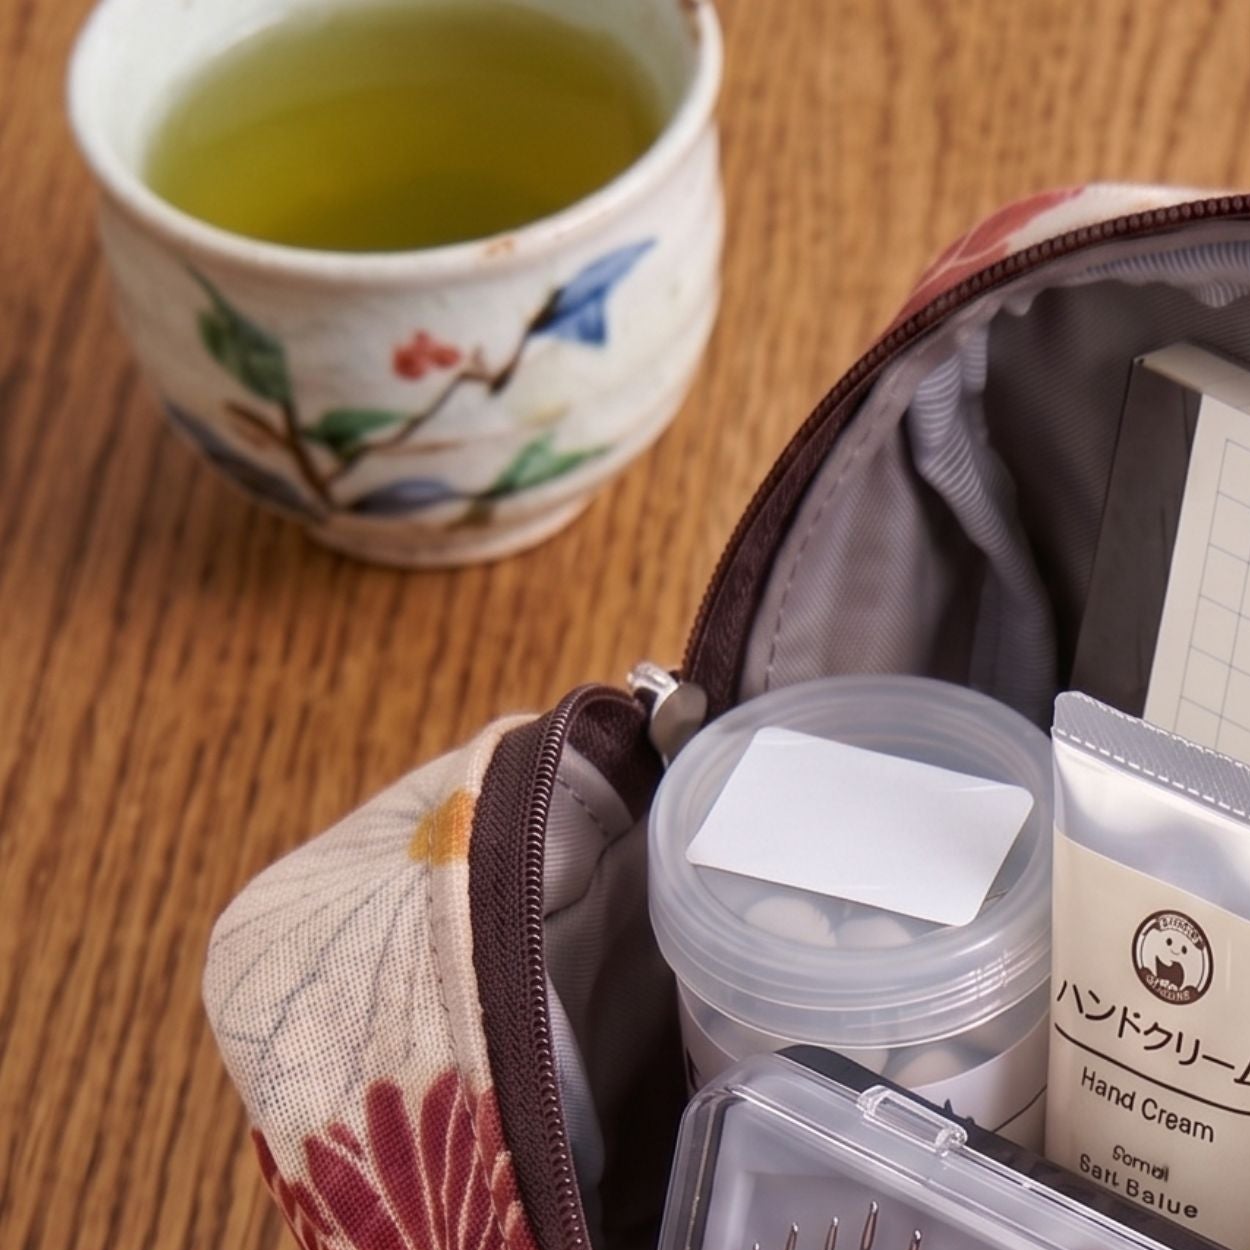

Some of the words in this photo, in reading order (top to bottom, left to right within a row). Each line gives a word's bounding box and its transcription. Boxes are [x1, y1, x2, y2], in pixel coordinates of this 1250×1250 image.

[1080, 1065, 1137, 1112] Hand
[1140, 1097, 1215, 1143] Cream
[1125, 1177, 1199, 1219] Balue
